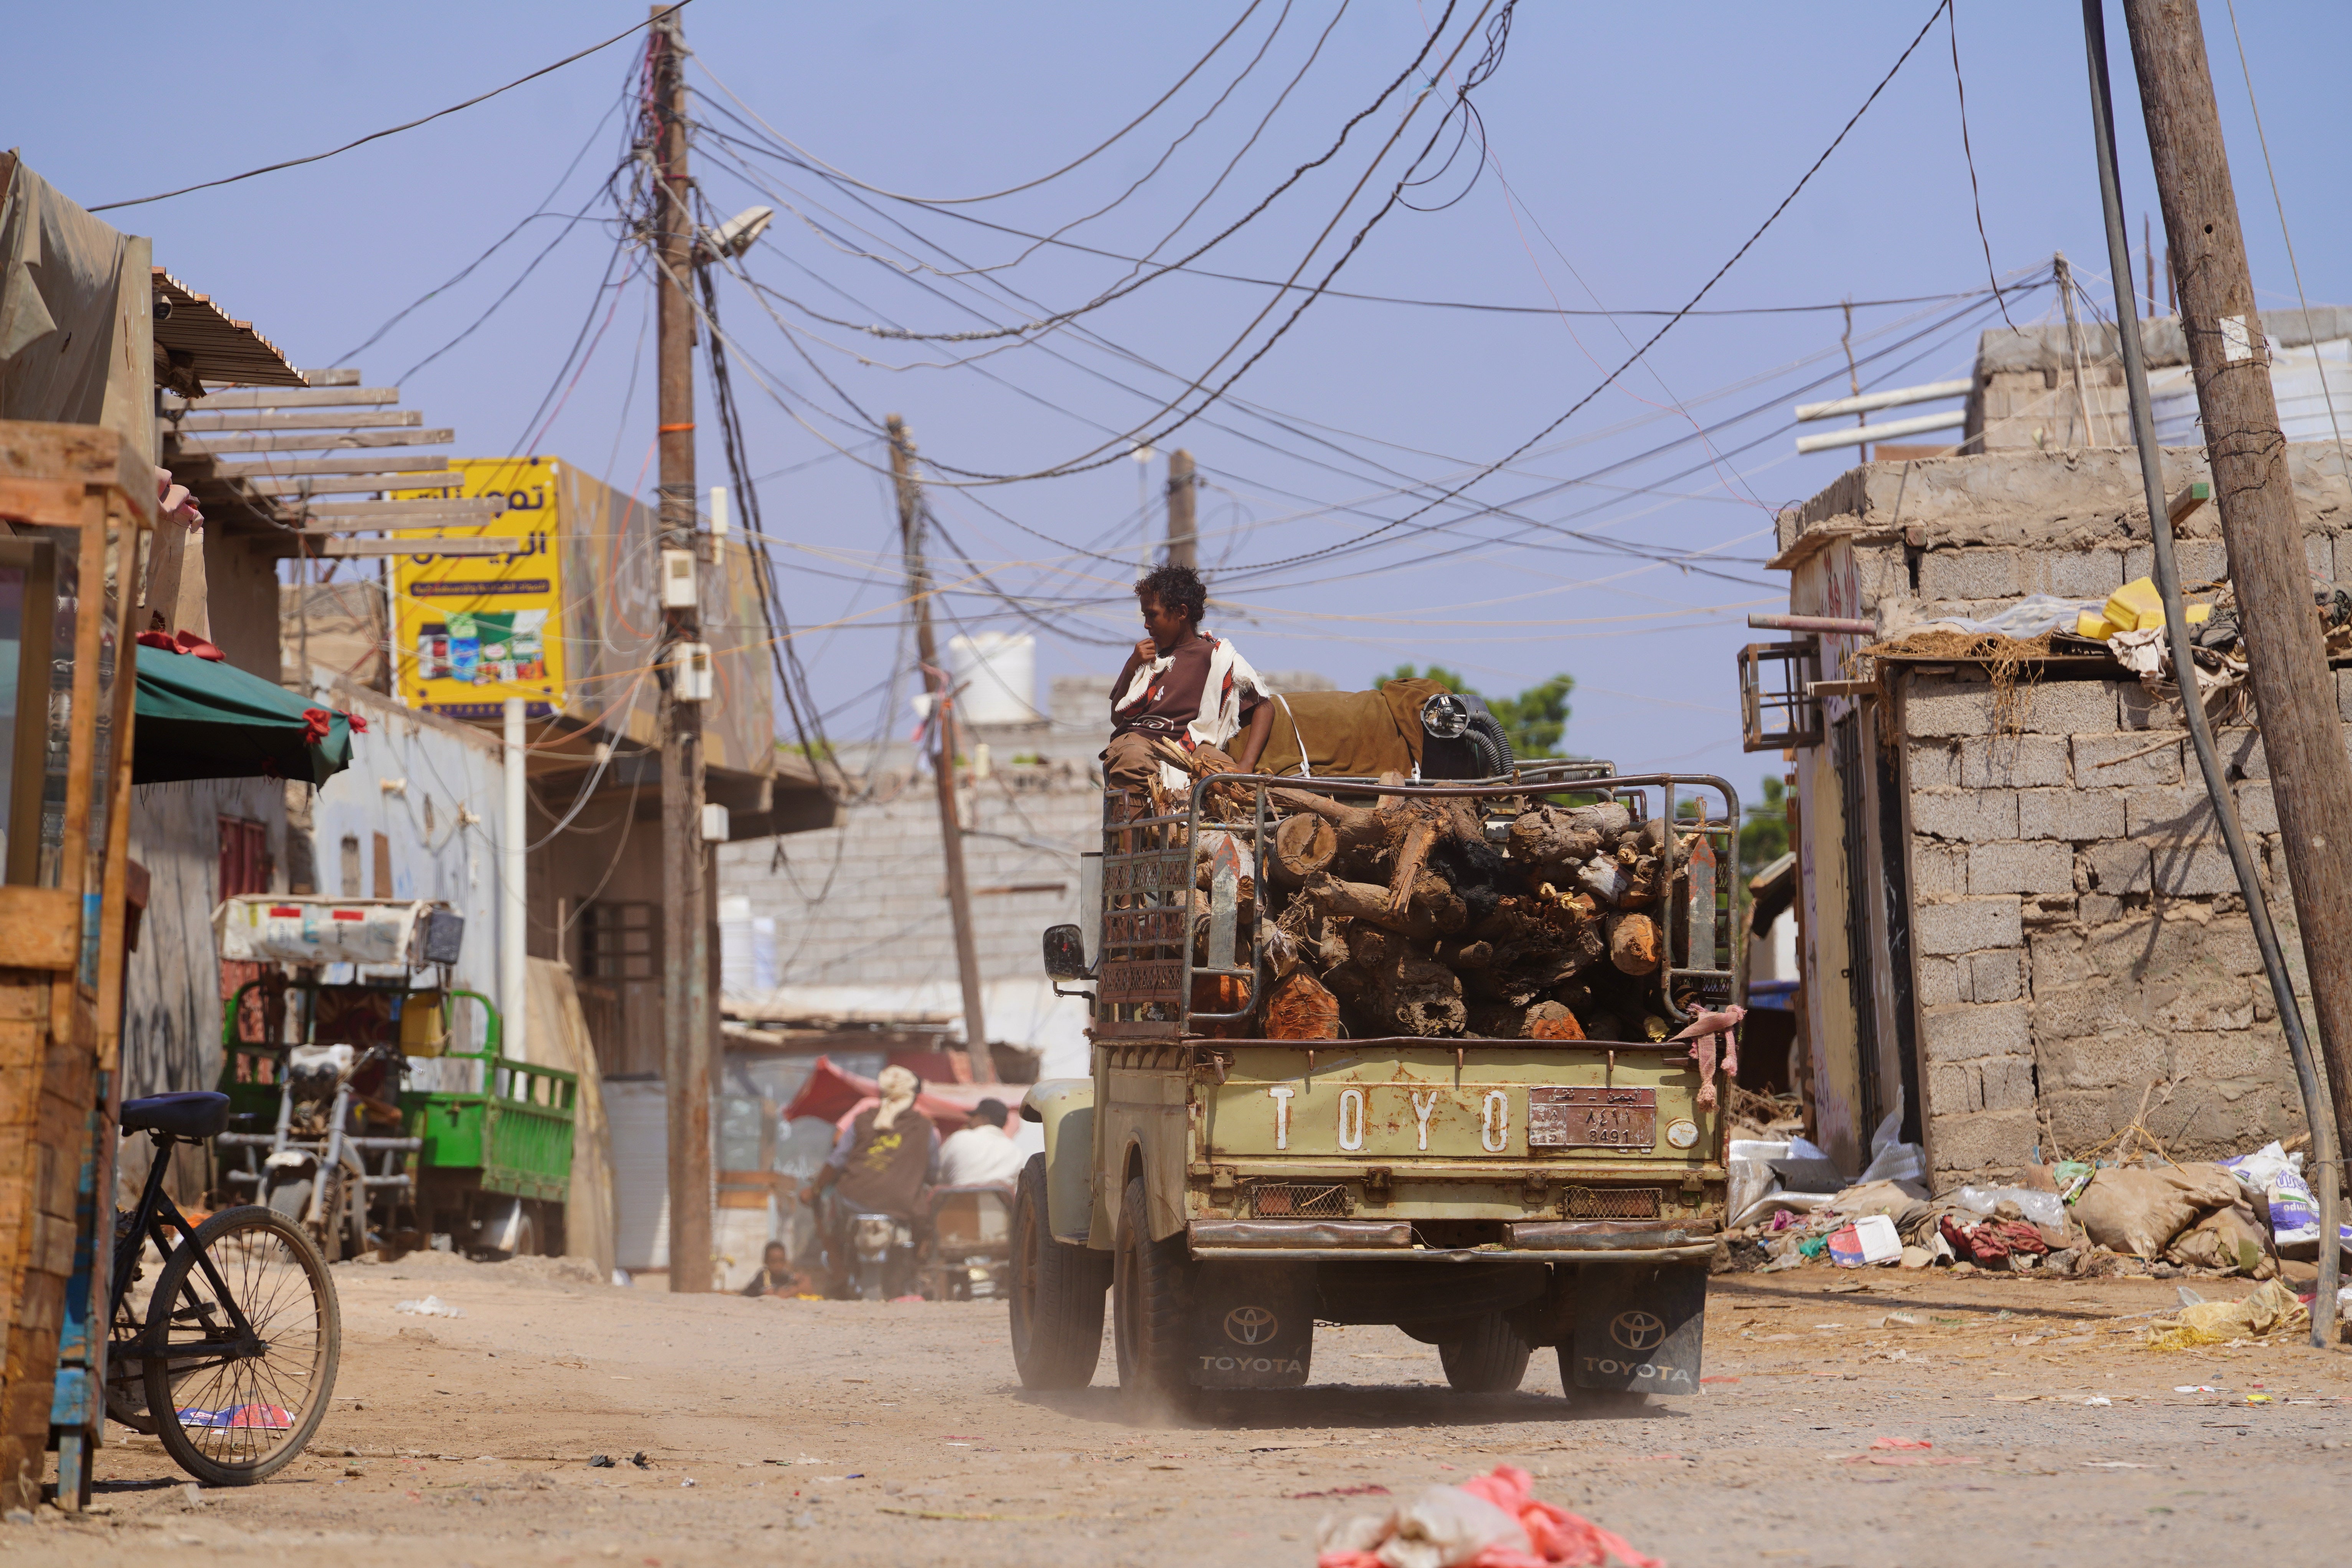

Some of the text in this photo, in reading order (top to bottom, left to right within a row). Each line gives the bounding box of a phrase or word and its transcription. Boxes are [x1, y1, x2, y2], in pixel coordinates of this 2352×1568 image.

[1549, 1089, 1575, 1103] نقل
[1606, 1090, 1642, 1105] اليمن
[1588, 1129, 1630, 1143] 8491
[1199, 1356, 1303, 1373] TOYOTA
[1583, 1357, 1692, 1385] TOYOTA
